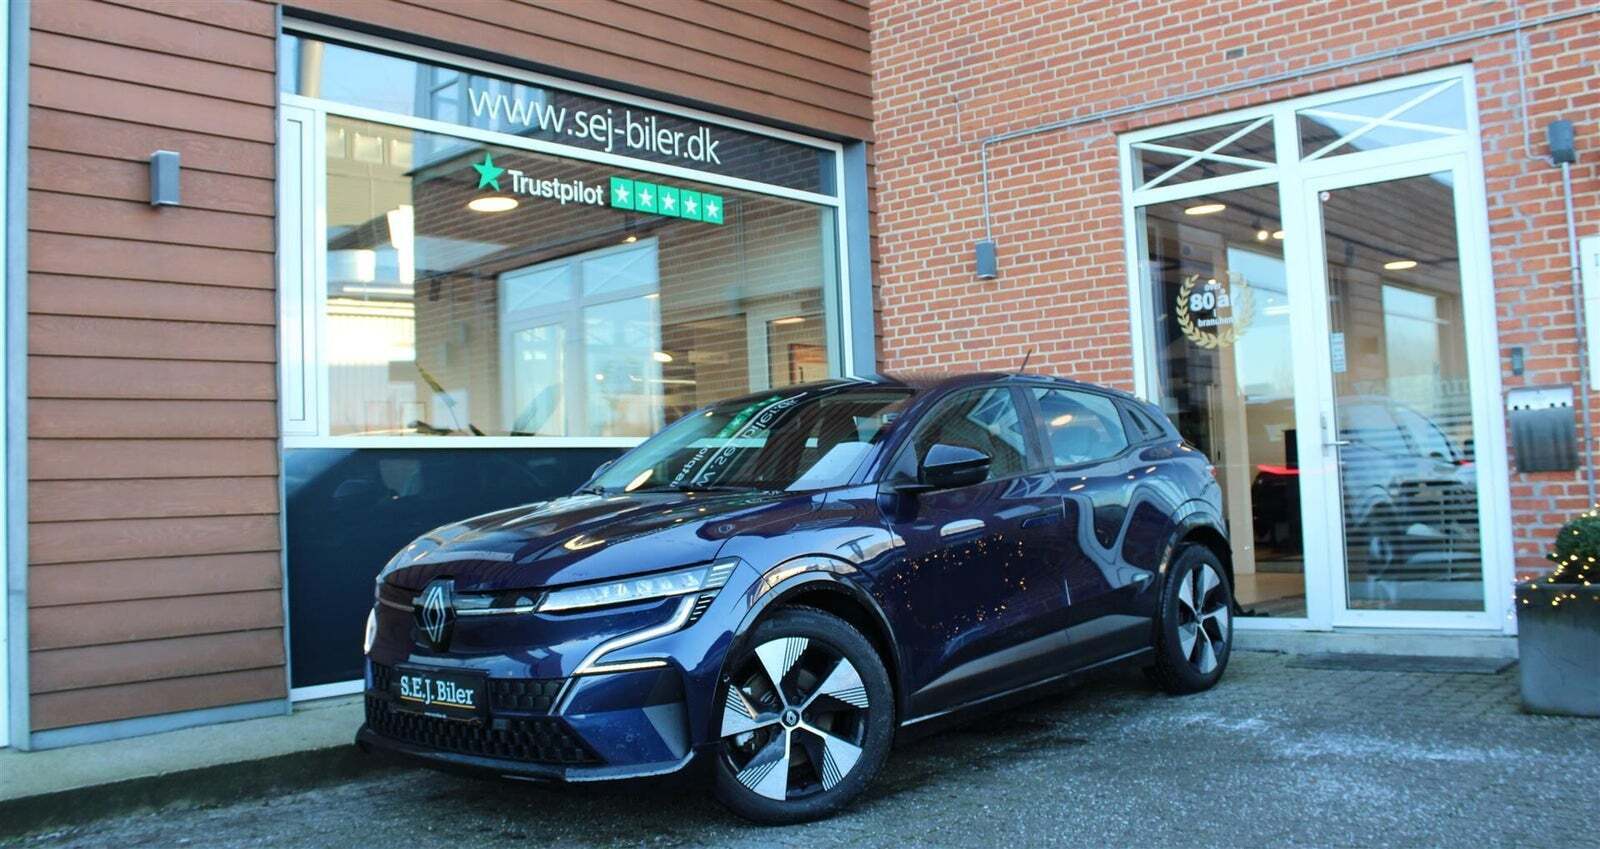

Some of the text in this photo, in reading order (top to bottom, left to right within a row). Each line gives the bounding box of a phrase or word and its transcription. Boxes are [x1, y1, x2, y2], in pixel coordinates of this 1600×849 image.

[468, 88, 721, 165] www.sej-biler.dk
[508, 169, 604, 206] Trustpilot
[1190, 288, 1236, 311] 80 å
[400, 675, 473, 705] S.E.J. Biler
